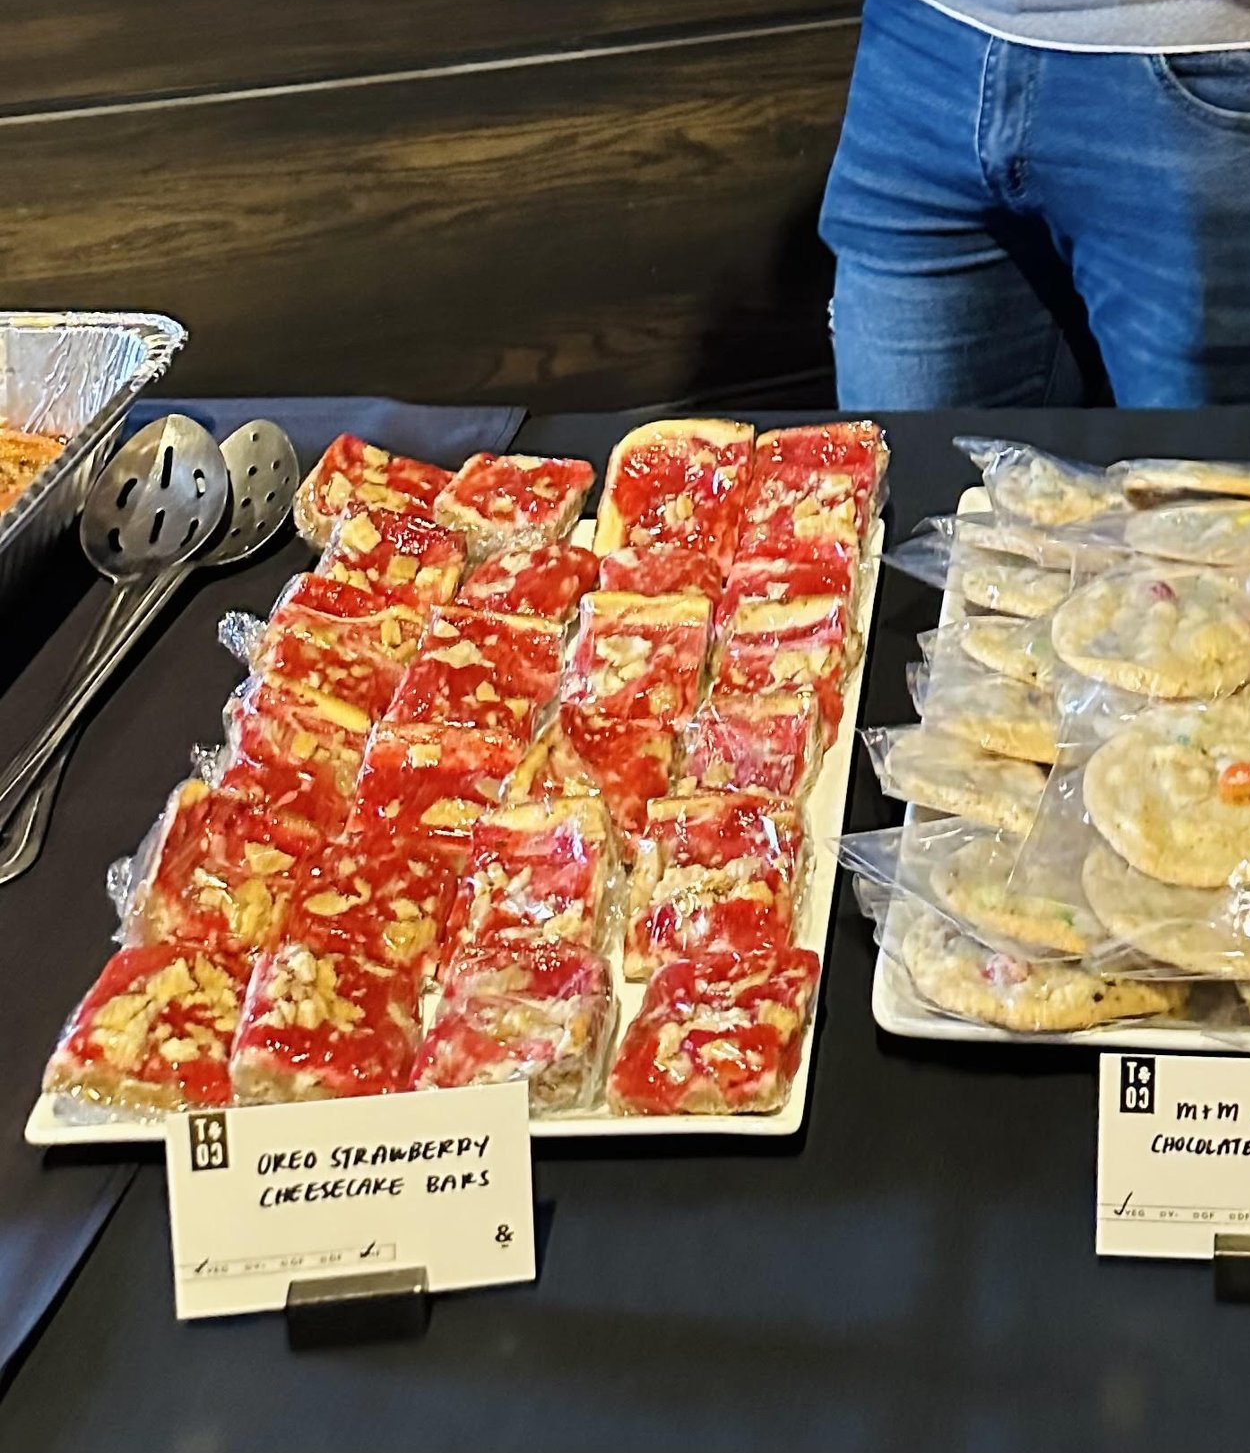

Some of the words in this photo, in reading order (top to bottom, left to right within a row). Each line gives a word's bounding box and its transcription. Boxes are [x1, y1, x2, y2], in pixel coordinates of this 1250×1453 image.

[257, 1150, 318, 1176] OREO
[330, 1134, 490, 1169] STRAWBERRY
[259, 1177, 404, 1208] CHEESECAKE
[426, 1169, 490, 1194] BARS
